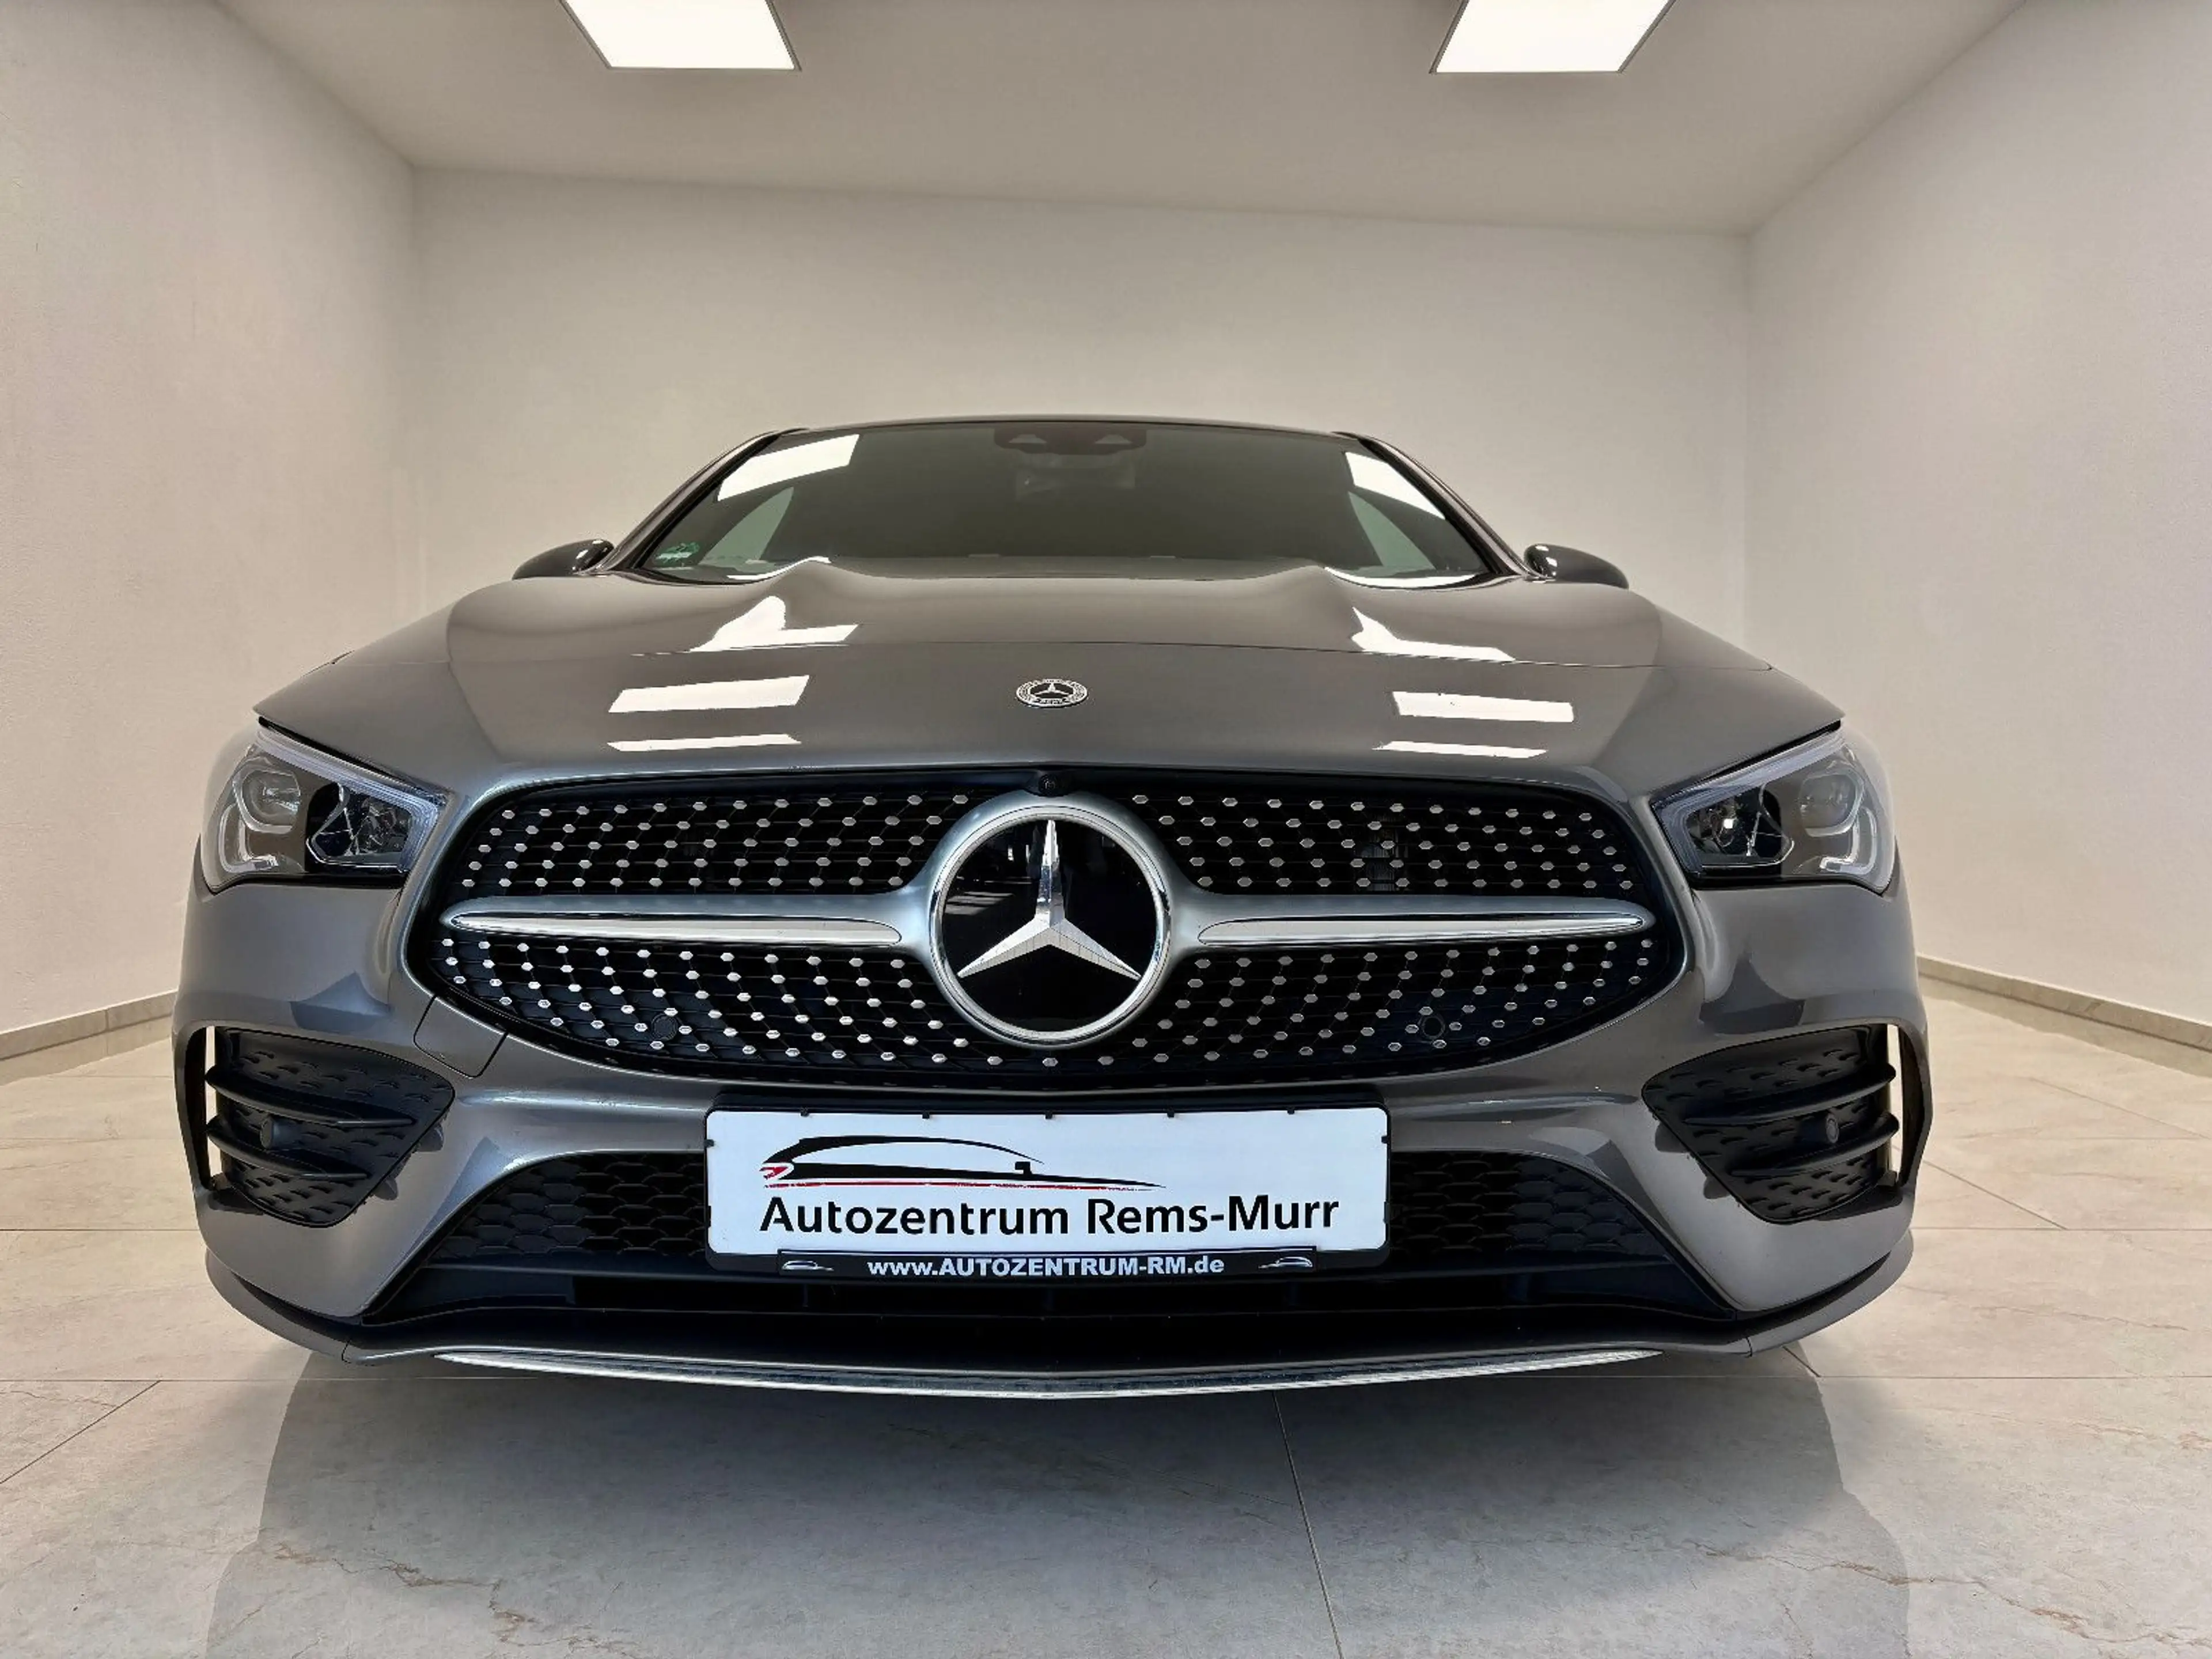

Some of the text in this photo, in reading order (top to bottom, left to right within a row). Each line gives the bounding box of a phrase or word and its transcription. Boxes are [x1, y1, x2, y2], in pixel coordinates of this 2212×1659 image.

[759, 1194, 1340, 1236] Autozentrum Rems-Murr
[867, 1255, 1225, 1277] www.AUTOZENTRUM-RM.de
